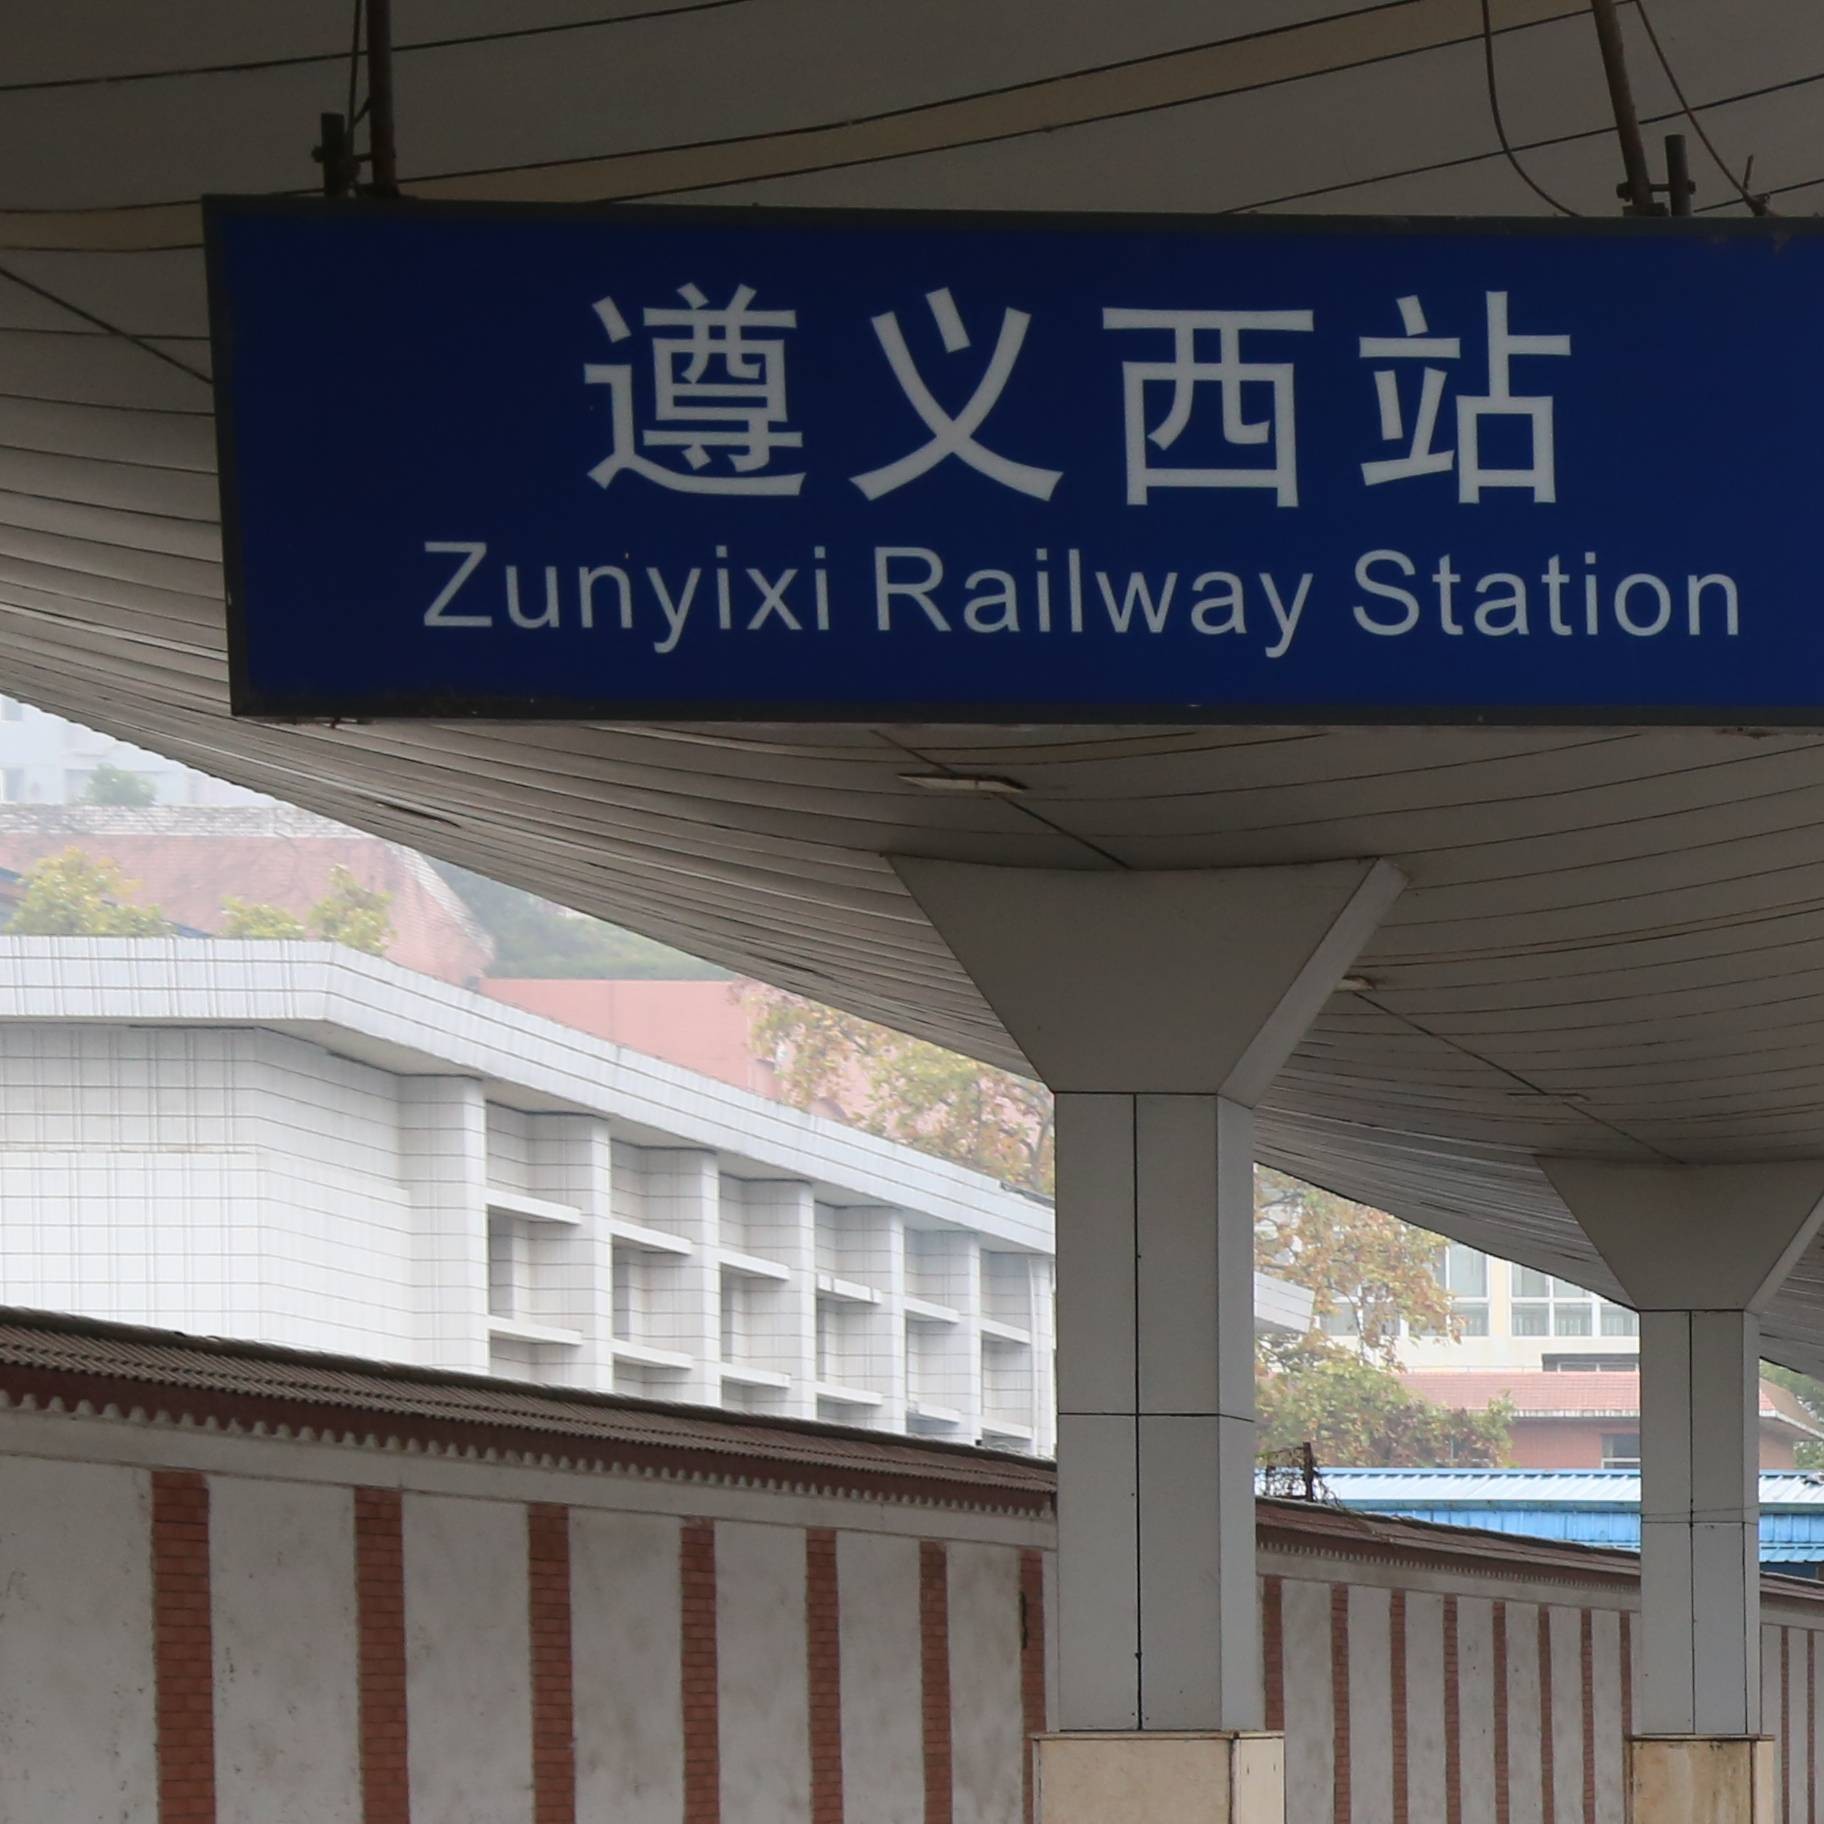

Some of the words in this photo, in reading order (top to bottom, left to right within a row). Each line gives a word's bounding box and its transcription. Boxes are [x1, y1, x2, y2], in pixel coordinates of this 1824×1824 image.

[585, 284, 1572, 508] 遵义西站
[423, 541, 830, 655] Zunyixi
[874, 546, 1313, 659] Railway
[1352, 548, 1739, 638] Station
